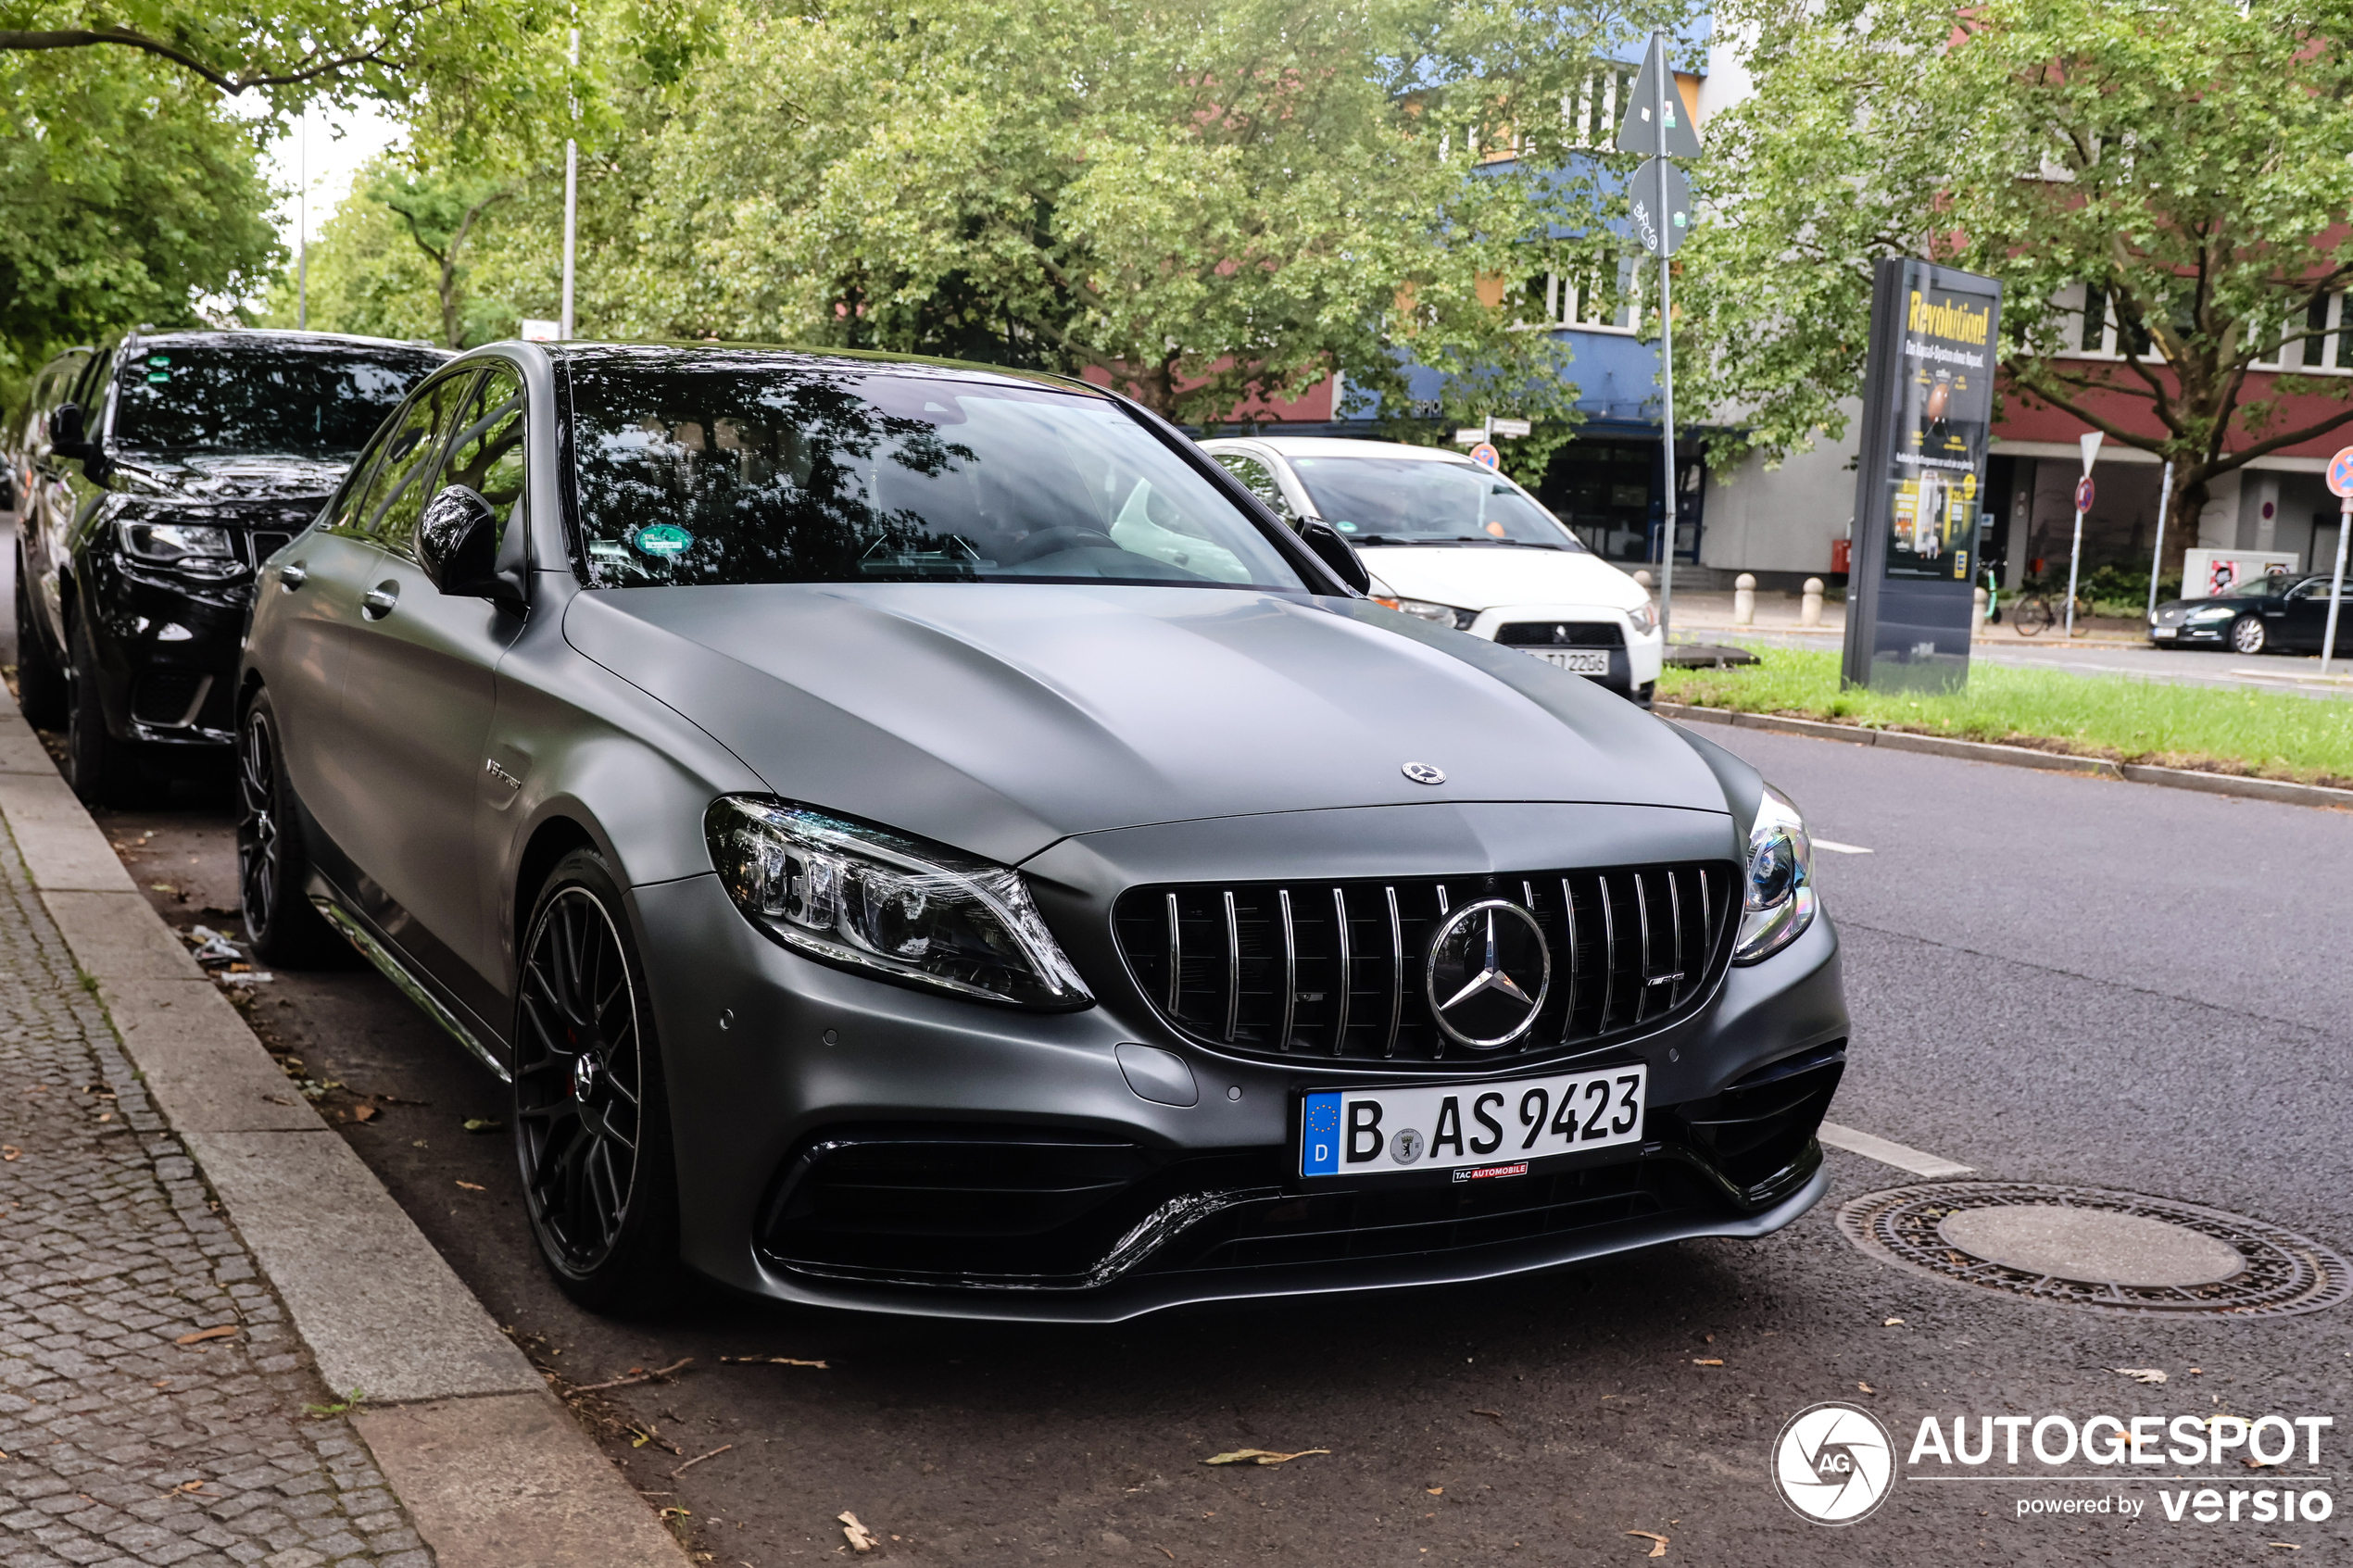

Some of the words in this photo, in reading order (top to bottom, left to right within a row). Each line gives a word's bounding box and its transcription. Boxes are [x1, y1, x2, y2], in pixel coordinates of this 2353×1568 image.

[1908, 290, 1989, 345] Revolution!
[1346, 1099, 1384, 1163] B
[1429, 1092, 1504, 1159] AS
[1519, 1074, 1640, 1149] 9423
[1315, 1144, 1328, 1162] D
[1455, 1171, 1472, 1180] TAC
[1471, 1164, 1526, 1178] AUTOMOBILE
